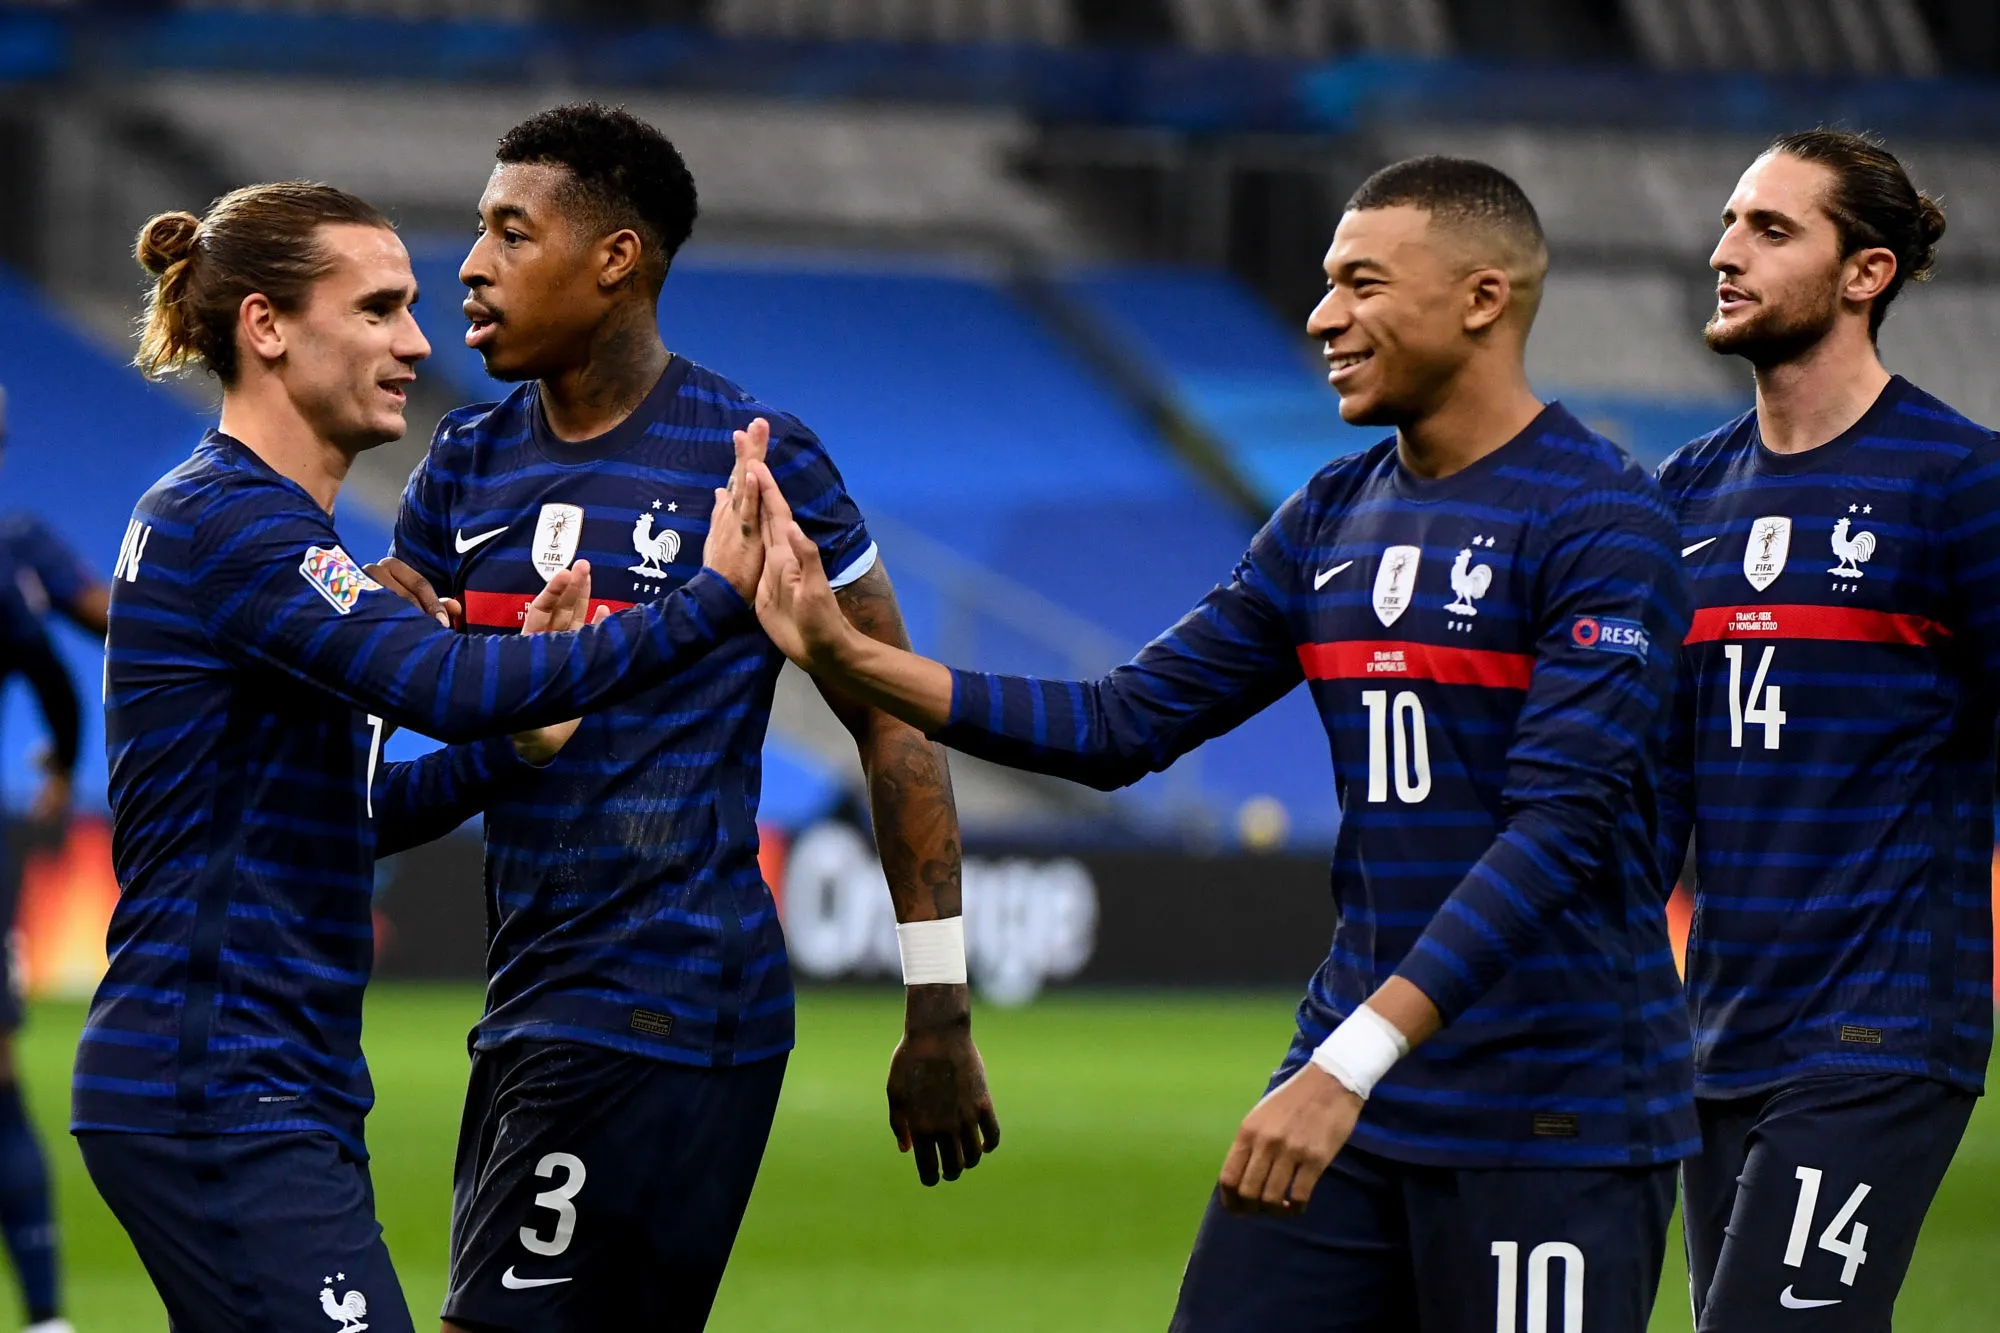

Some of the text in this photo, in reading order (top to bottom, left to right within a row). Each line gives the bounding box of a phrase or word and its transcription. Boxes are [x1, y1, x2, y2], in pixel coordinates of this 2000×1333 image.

[543, 553, 561, 562] FIFA
[1728, 622, 1736, 631] 17
[1762, 621, 1778, 631] 2020
[1362, 690, 1432, 803] 10
[1725, 644, 1787, 749] 14
[519, 1152, 586, 1256] 3
[1783, 1165, 1871, 1287] 14
[1491, 1241, 1584, 1333] 10
